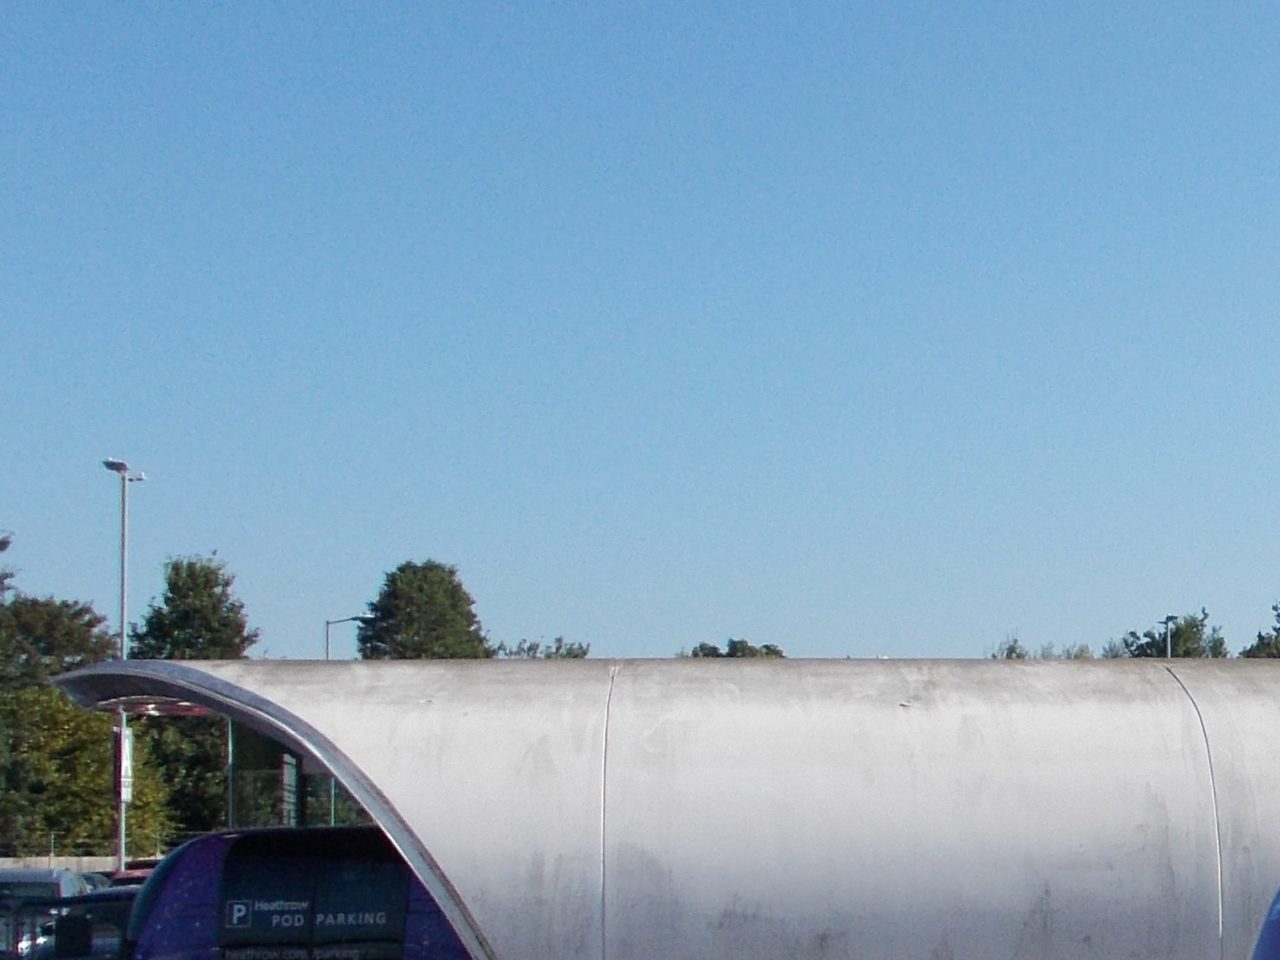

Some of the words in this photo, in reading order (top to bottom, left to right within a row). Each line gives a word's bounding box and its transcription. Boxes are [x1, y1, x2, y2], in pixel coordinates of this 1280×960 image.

[254, 900, 310, 911] Heathrow
[232, 904, 246, 925] P
[272, 914, 305, 928] POD
[316, 912, 387, 926] PARKING
